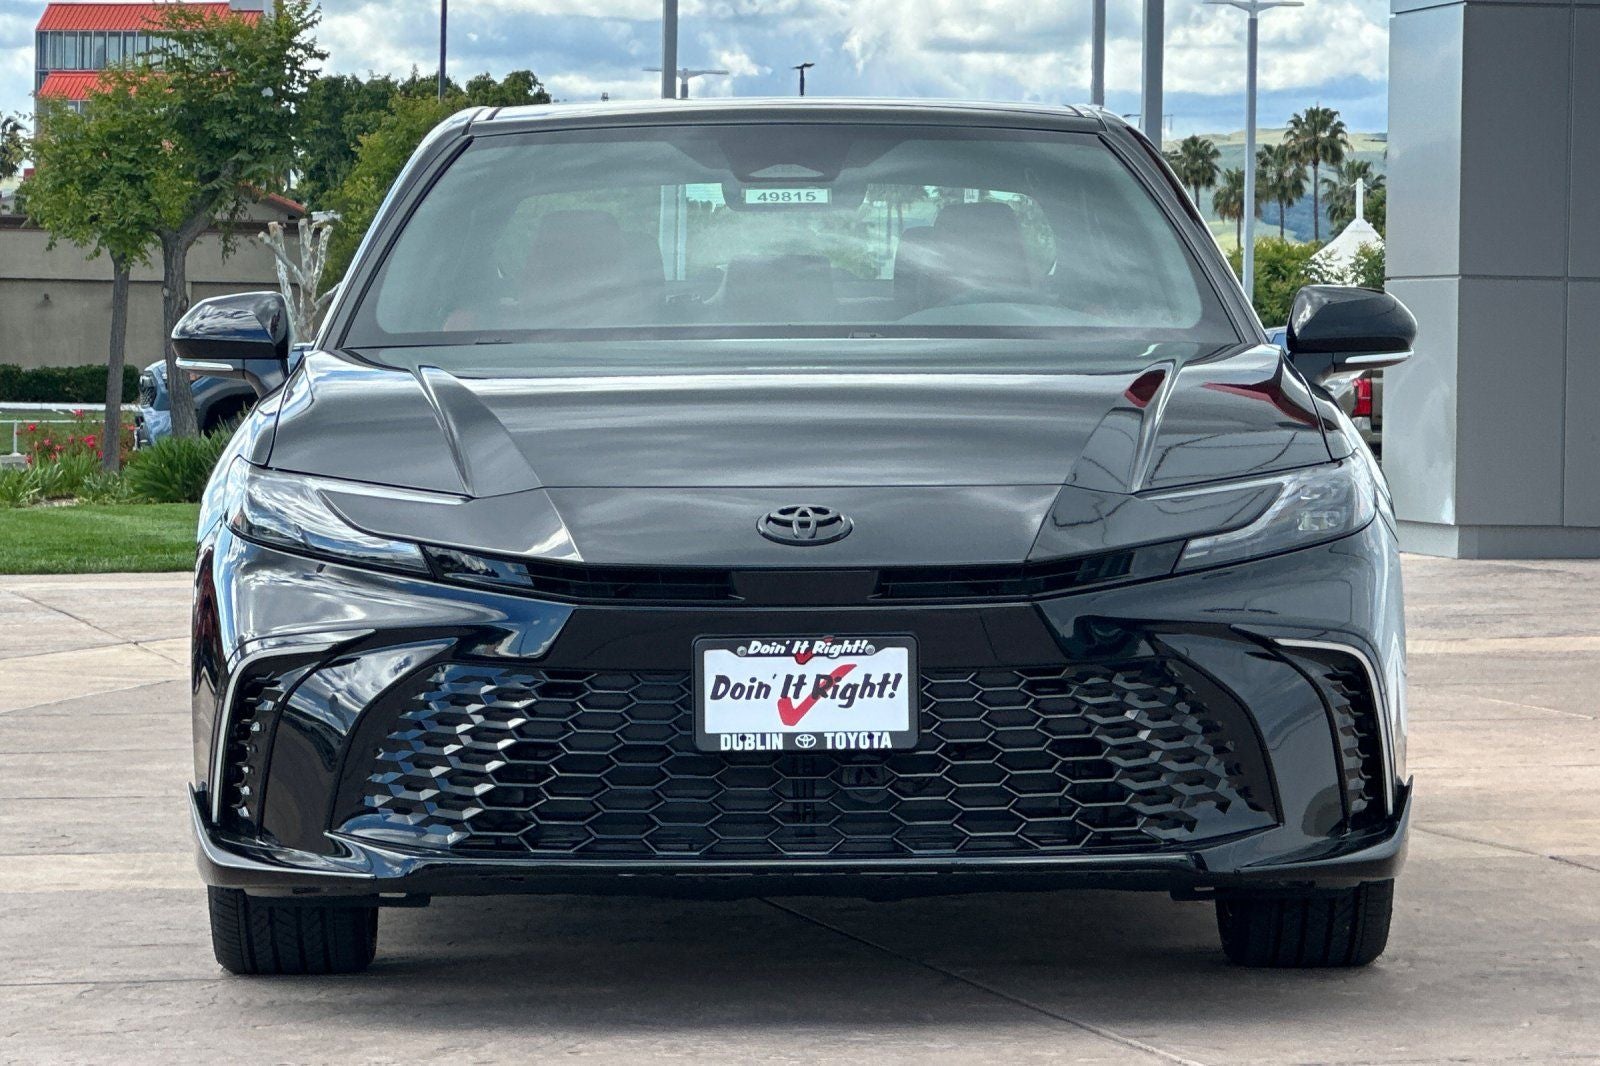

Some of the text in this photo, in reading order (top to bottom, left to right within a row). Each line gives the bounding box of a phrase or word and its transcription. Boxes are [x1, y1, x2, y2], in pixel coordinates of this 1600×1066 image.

[757, 191, 817, 202] 49815
[748, 639, 868, 658] Doin' It Right!
[710, 672, 902, 708] Doin' It Right!
[720, 732, 892, 750] DUBLIN TOYOTA
